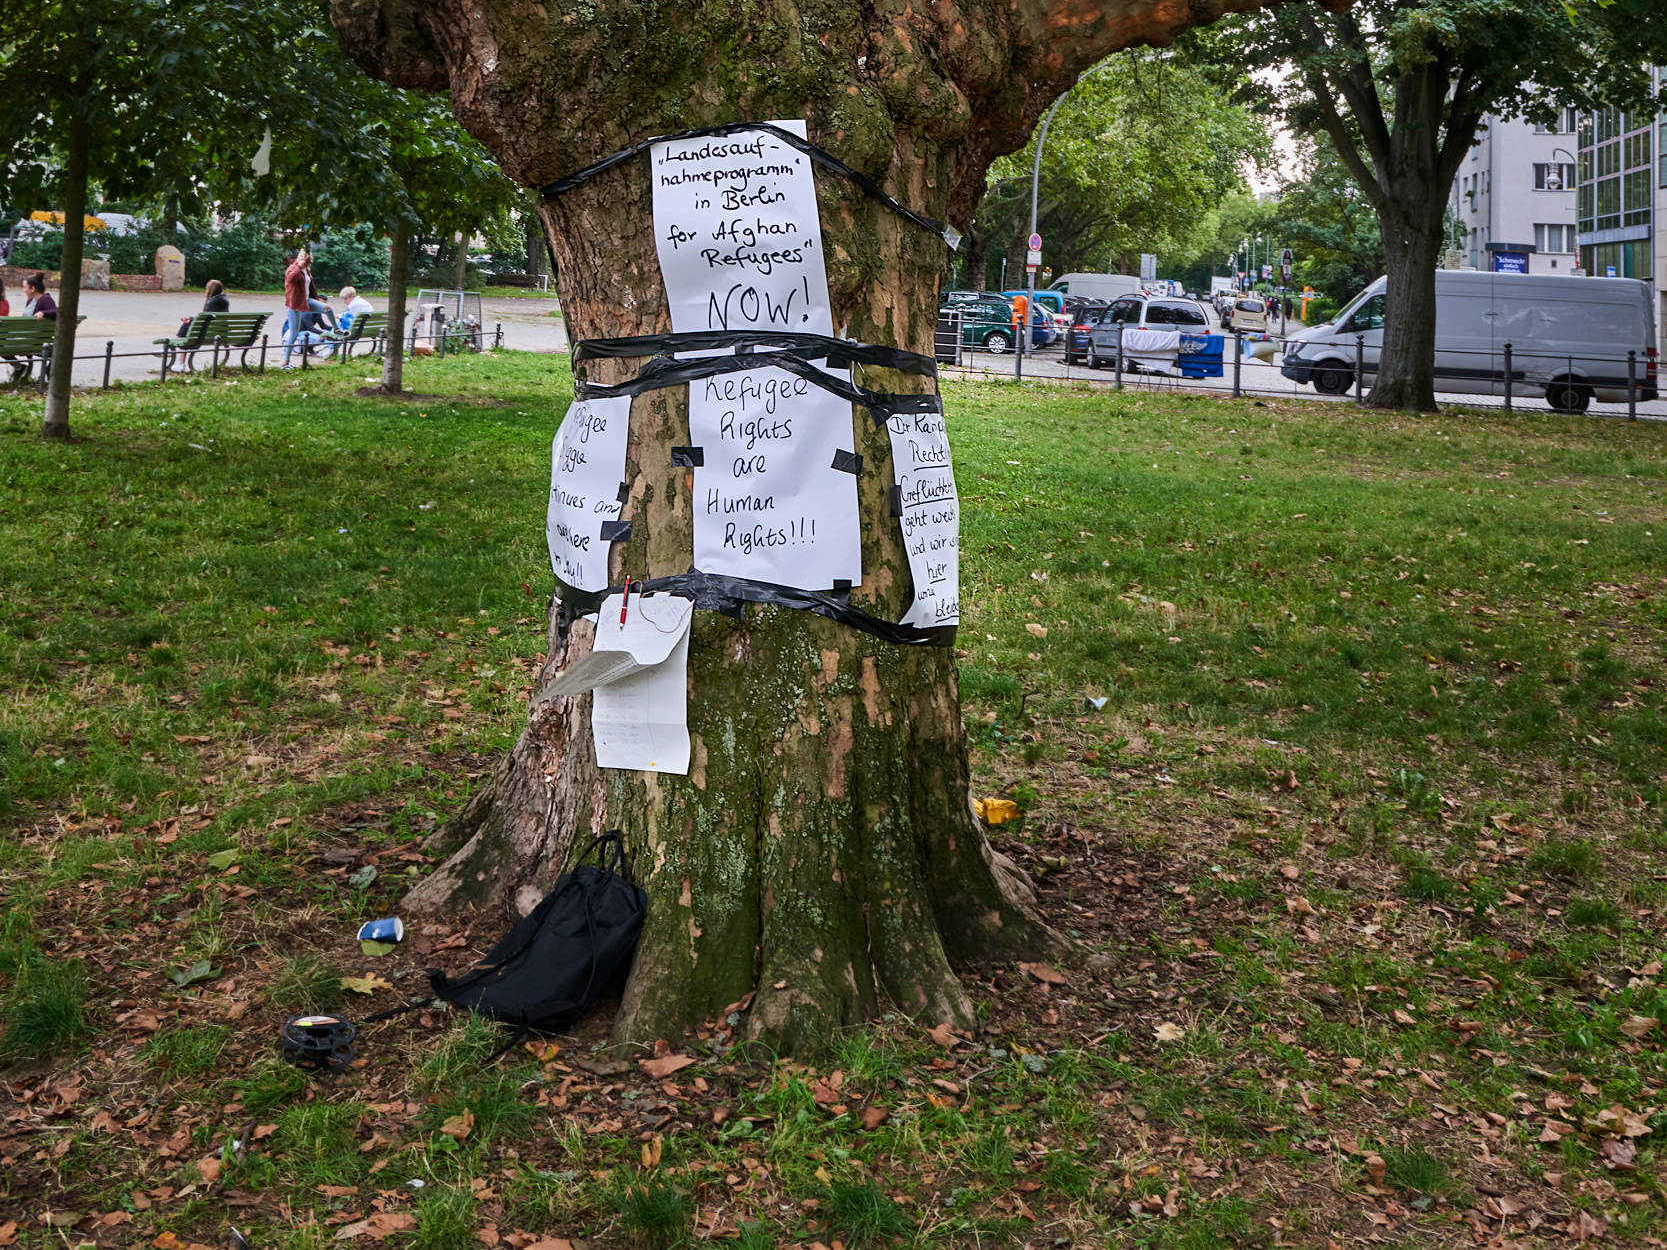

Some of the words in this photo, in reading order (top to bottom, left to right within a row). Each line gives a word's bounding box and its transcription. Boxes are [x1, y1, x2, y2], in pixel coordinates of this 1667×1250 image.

[695, 193, 711, 209] in
[721, 182, 786, 211] Berlin
[667, 224, 698, 250] for
[712, 218, 798, 247] Afghan
[708, 275, 810, 331] NOW!
[704, 376, 809, 414] Refugee
[720, 411, 793, 450] Rights
[733, 455, 767, 478] are
[707, 488, 775, 515] Human
[724, 516, 816, 555] Rights!!!
[909, 537, 926, 557] und
[930, 534, 947, 551] wir
[926, 558, 948, 579] hier
